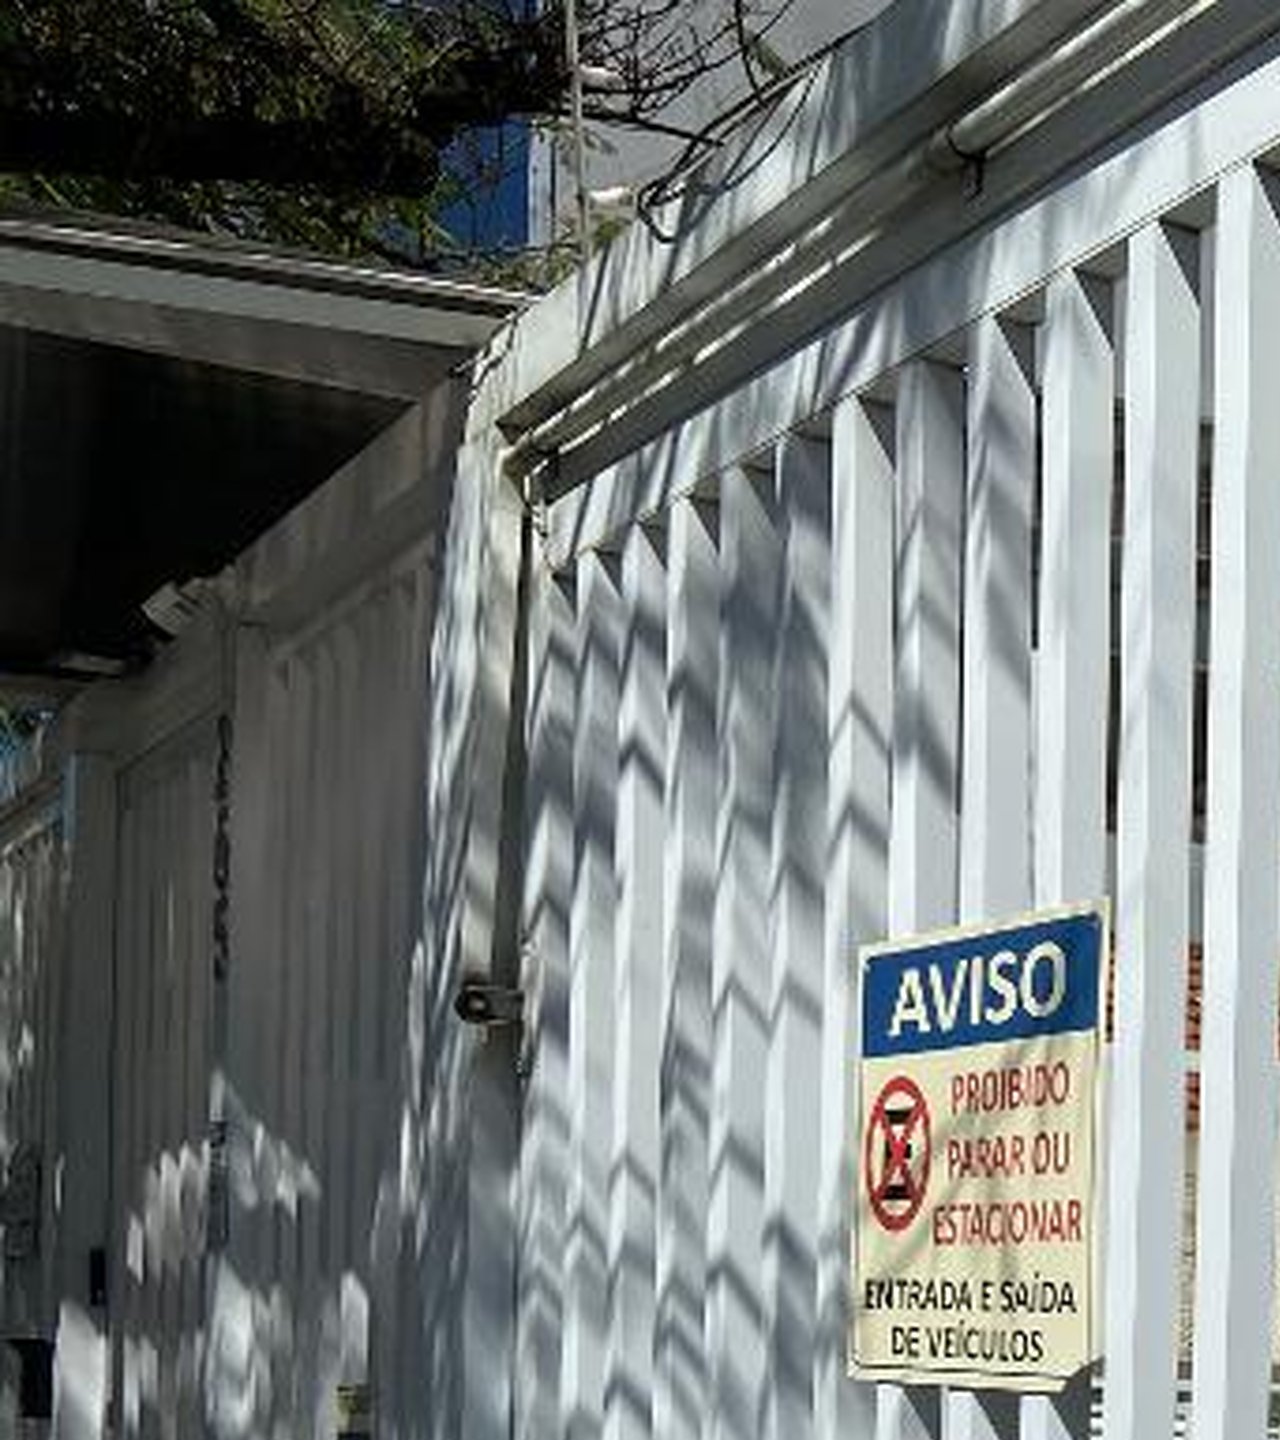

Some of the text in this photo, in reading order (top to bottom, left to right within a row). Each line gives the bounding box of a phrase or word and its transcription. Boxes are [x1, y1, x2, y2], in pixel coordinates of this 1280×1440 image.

[887, 942, 1067, 1037] AVISO
[952, 1062, 1070, 1116] PROIBIDO
[948, 1132, 1070, 1180] PARAR OU
[933, 1200, 1082, 1246] ESTACIONAR
[865, 1272, 1077, 1315] ENTRADA E SAÍDA
[892, 1318, 1044, 1362] DE VEÍCULOS
